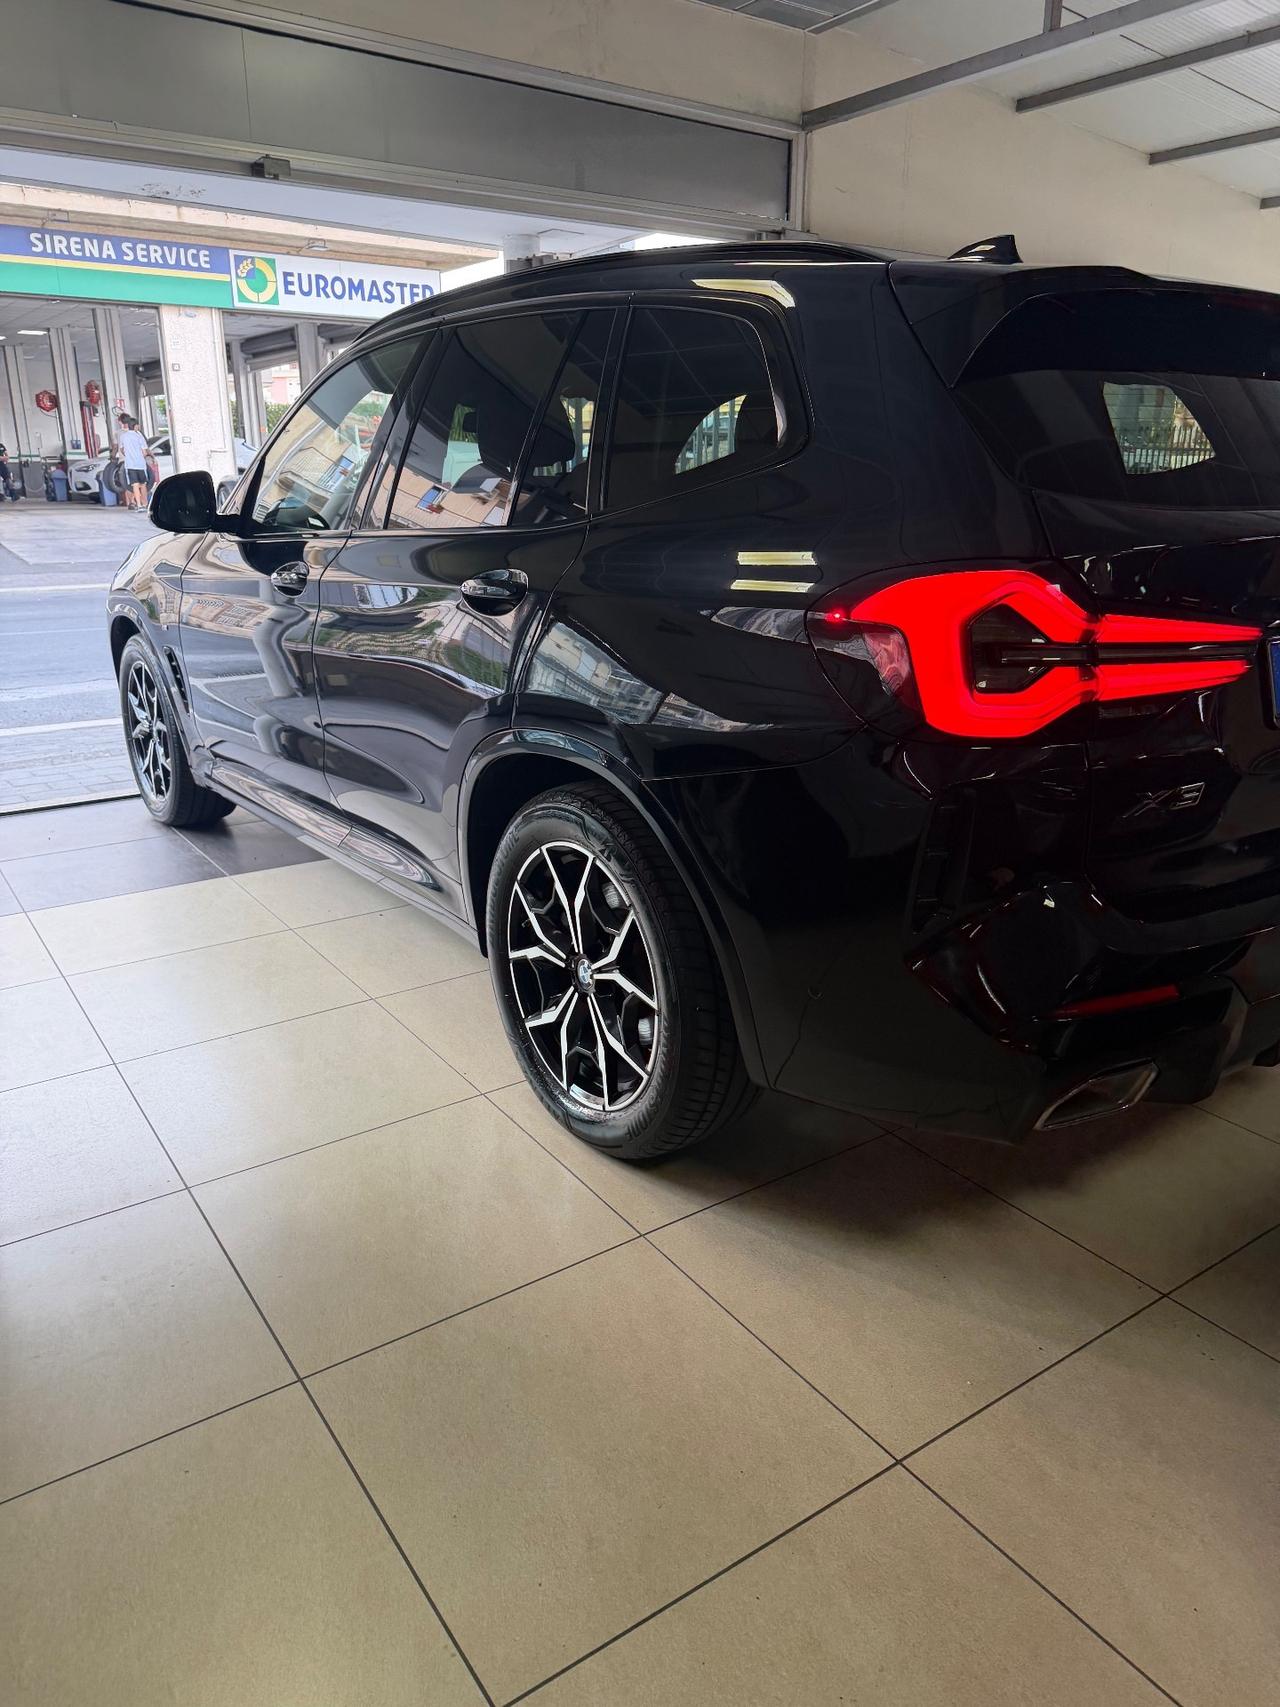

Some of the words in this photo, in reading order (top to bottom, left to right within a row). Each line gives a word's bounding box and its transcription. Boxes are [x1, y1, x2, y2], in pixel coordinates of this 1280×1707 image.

[29, 232, 117, 260] SIRENA
[121, 242, 211, 268] SERVICE
[1122, 781, 1206, 818] X3
